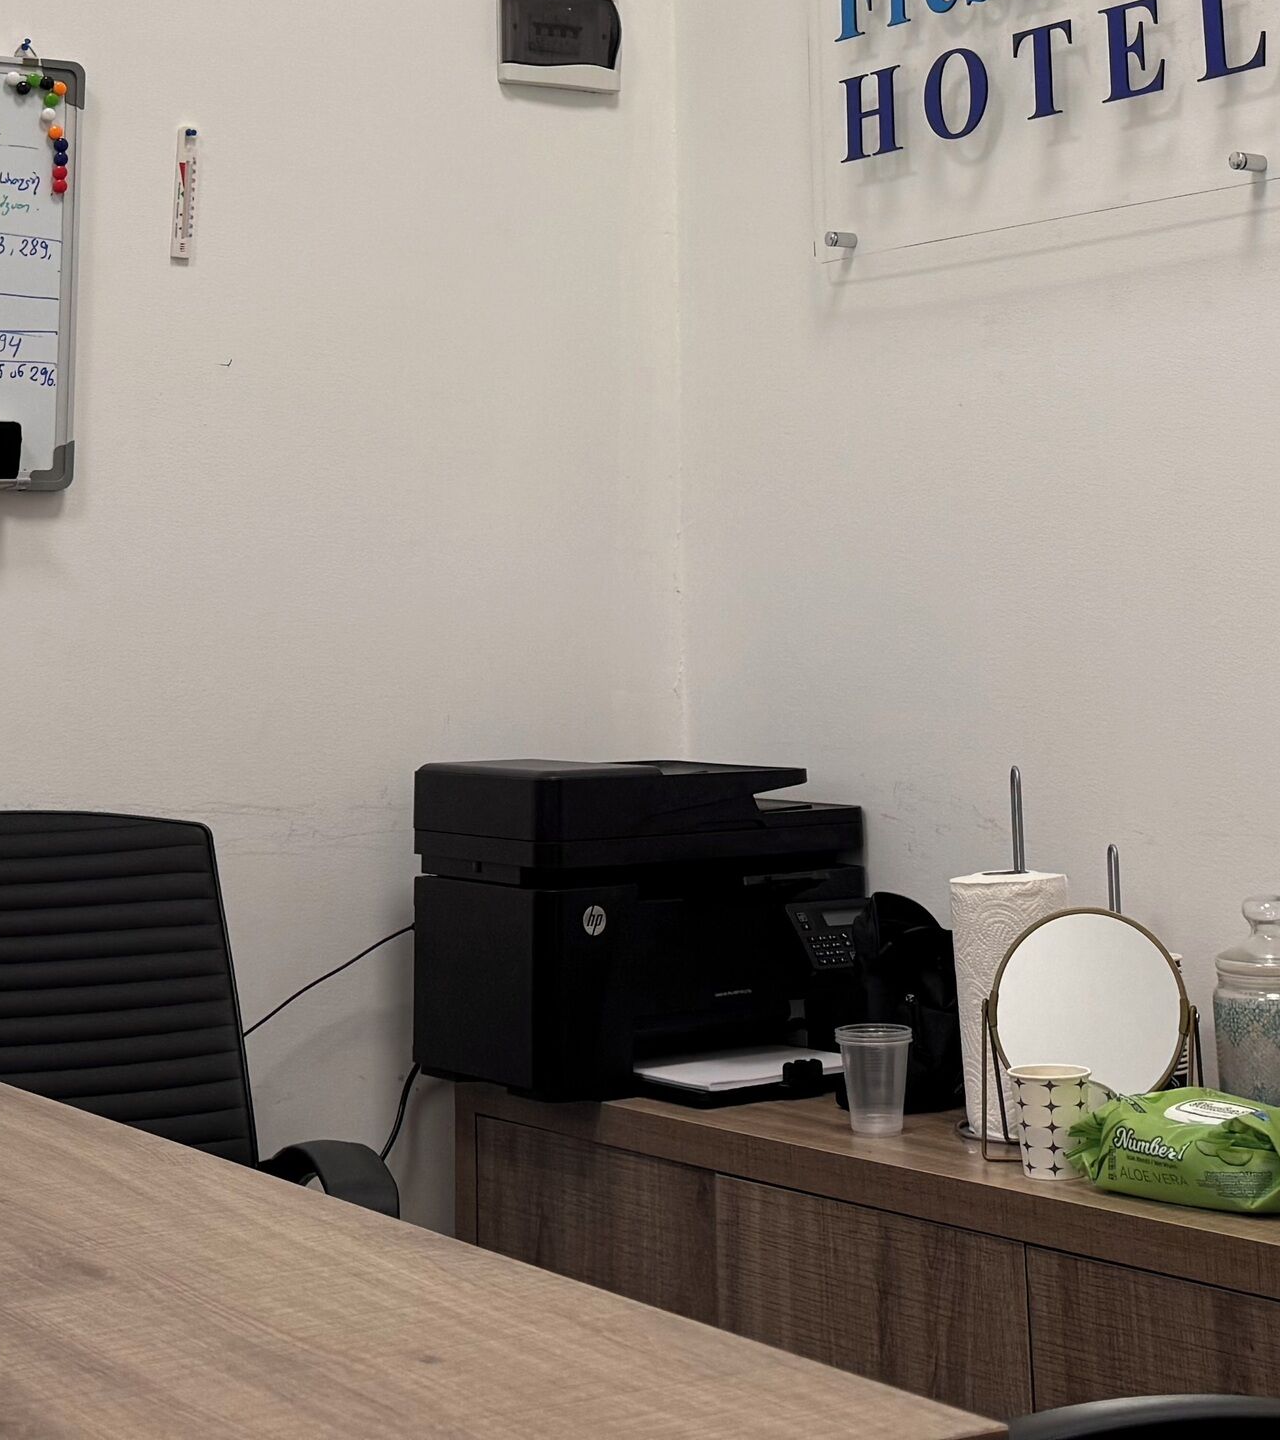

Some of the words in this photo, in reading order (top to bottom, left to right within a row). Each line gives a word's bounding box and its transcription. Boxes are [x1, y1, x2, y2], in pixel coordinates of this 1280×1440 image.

[584, 905, 606, 936] hp
[1120, 1167, 1153, 1182] ALOE
[1154, 1170, 1189, 1185] VERA
